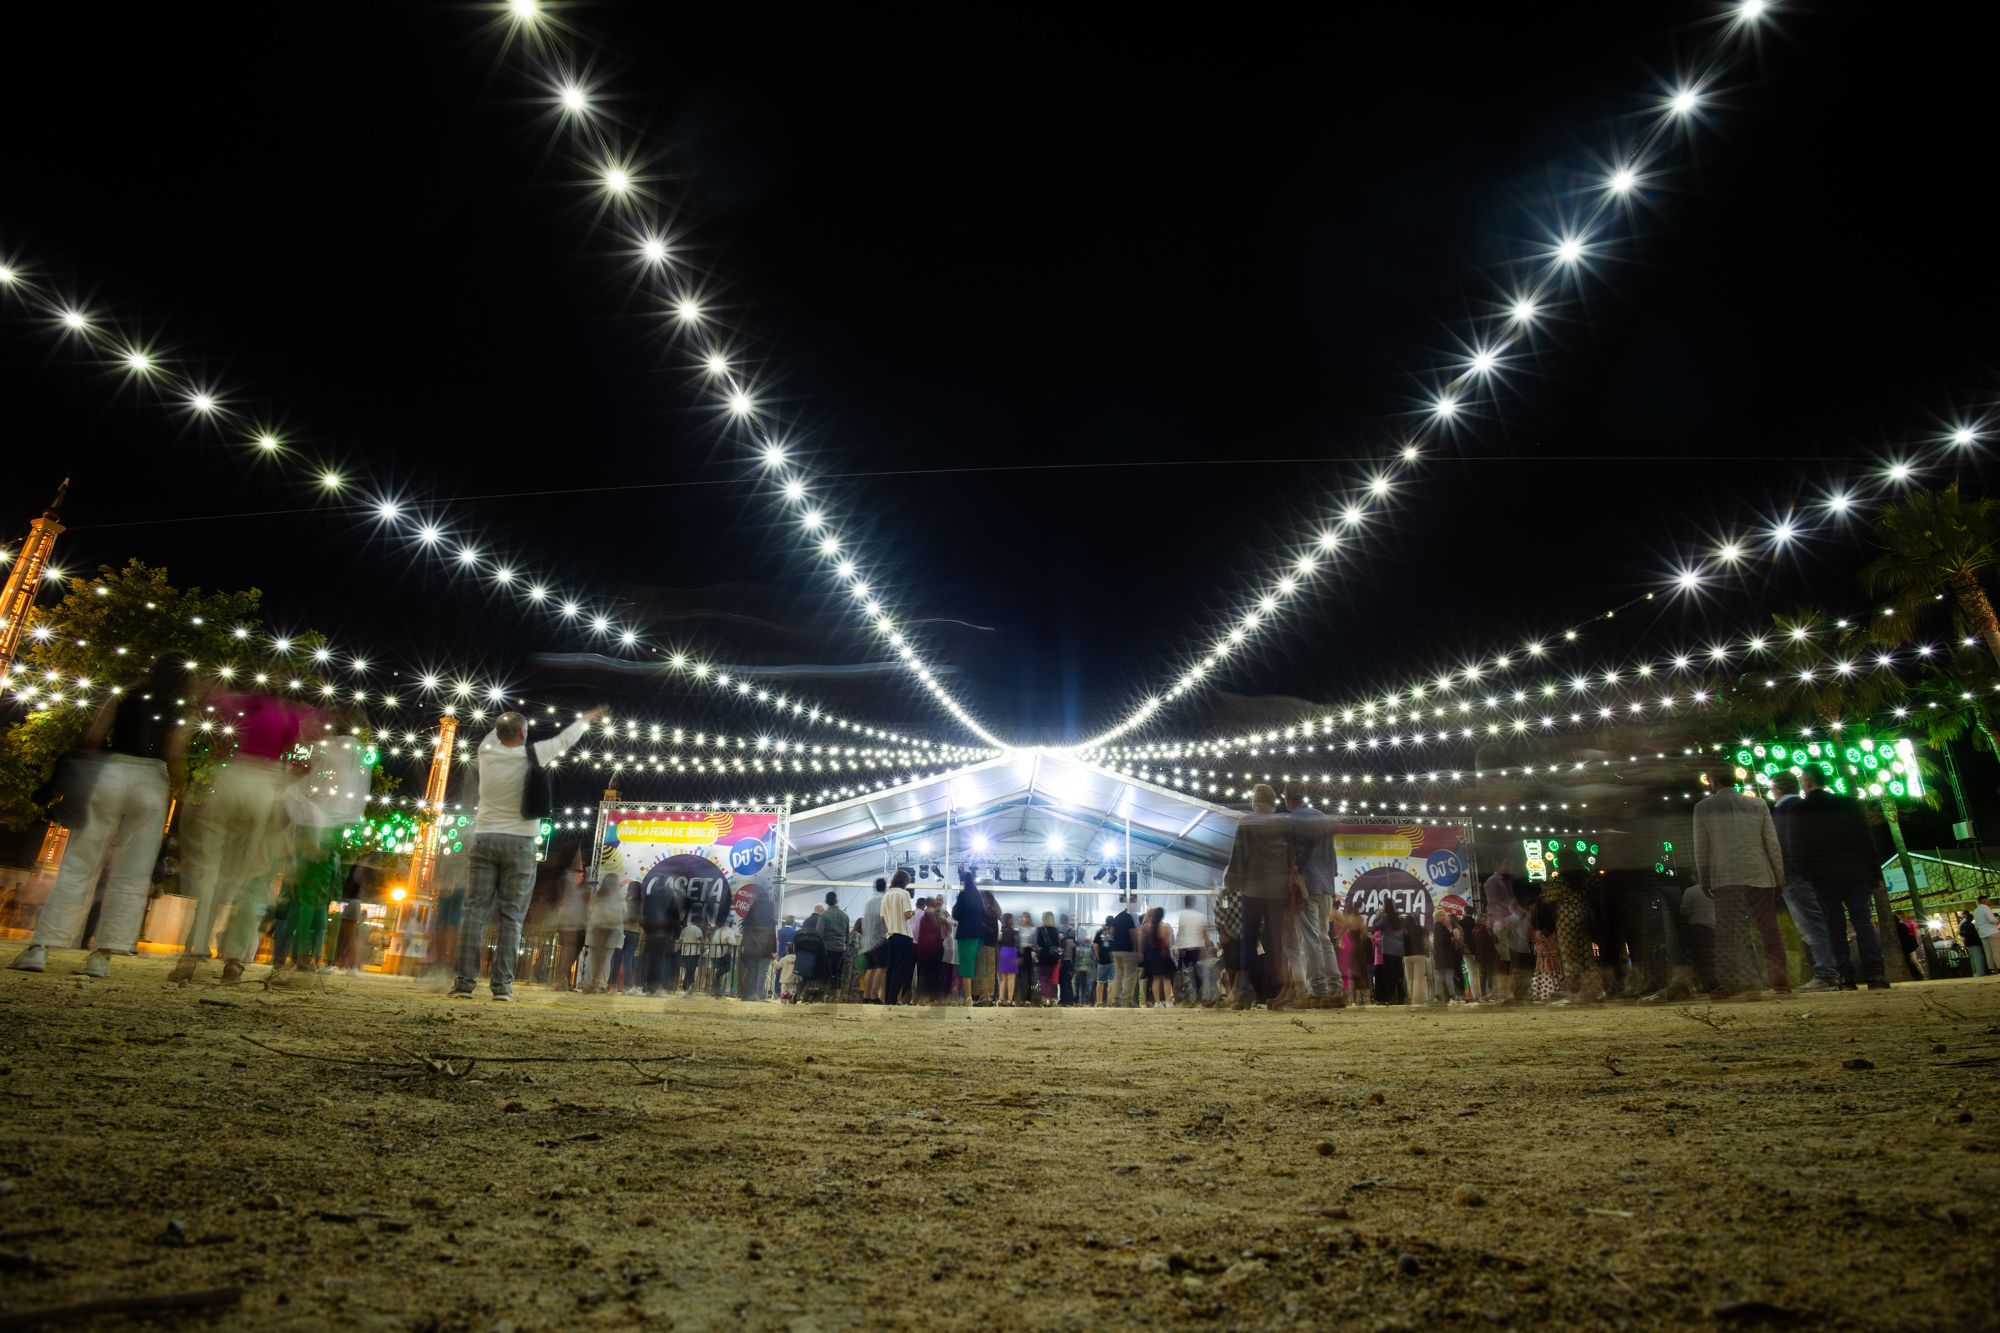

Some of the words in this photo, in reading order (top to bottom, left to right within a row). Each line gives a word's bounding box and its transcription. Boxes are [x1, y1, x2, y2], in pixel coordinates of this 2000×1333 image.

[639, 826, 649, 836] LA
[674, 827, 685, 837] DE
[733, 845, 764, 868] DJ'S
[1429, 857, 1457, 880] DJ'S
[1352, 889, 1425, 914] CASETA
